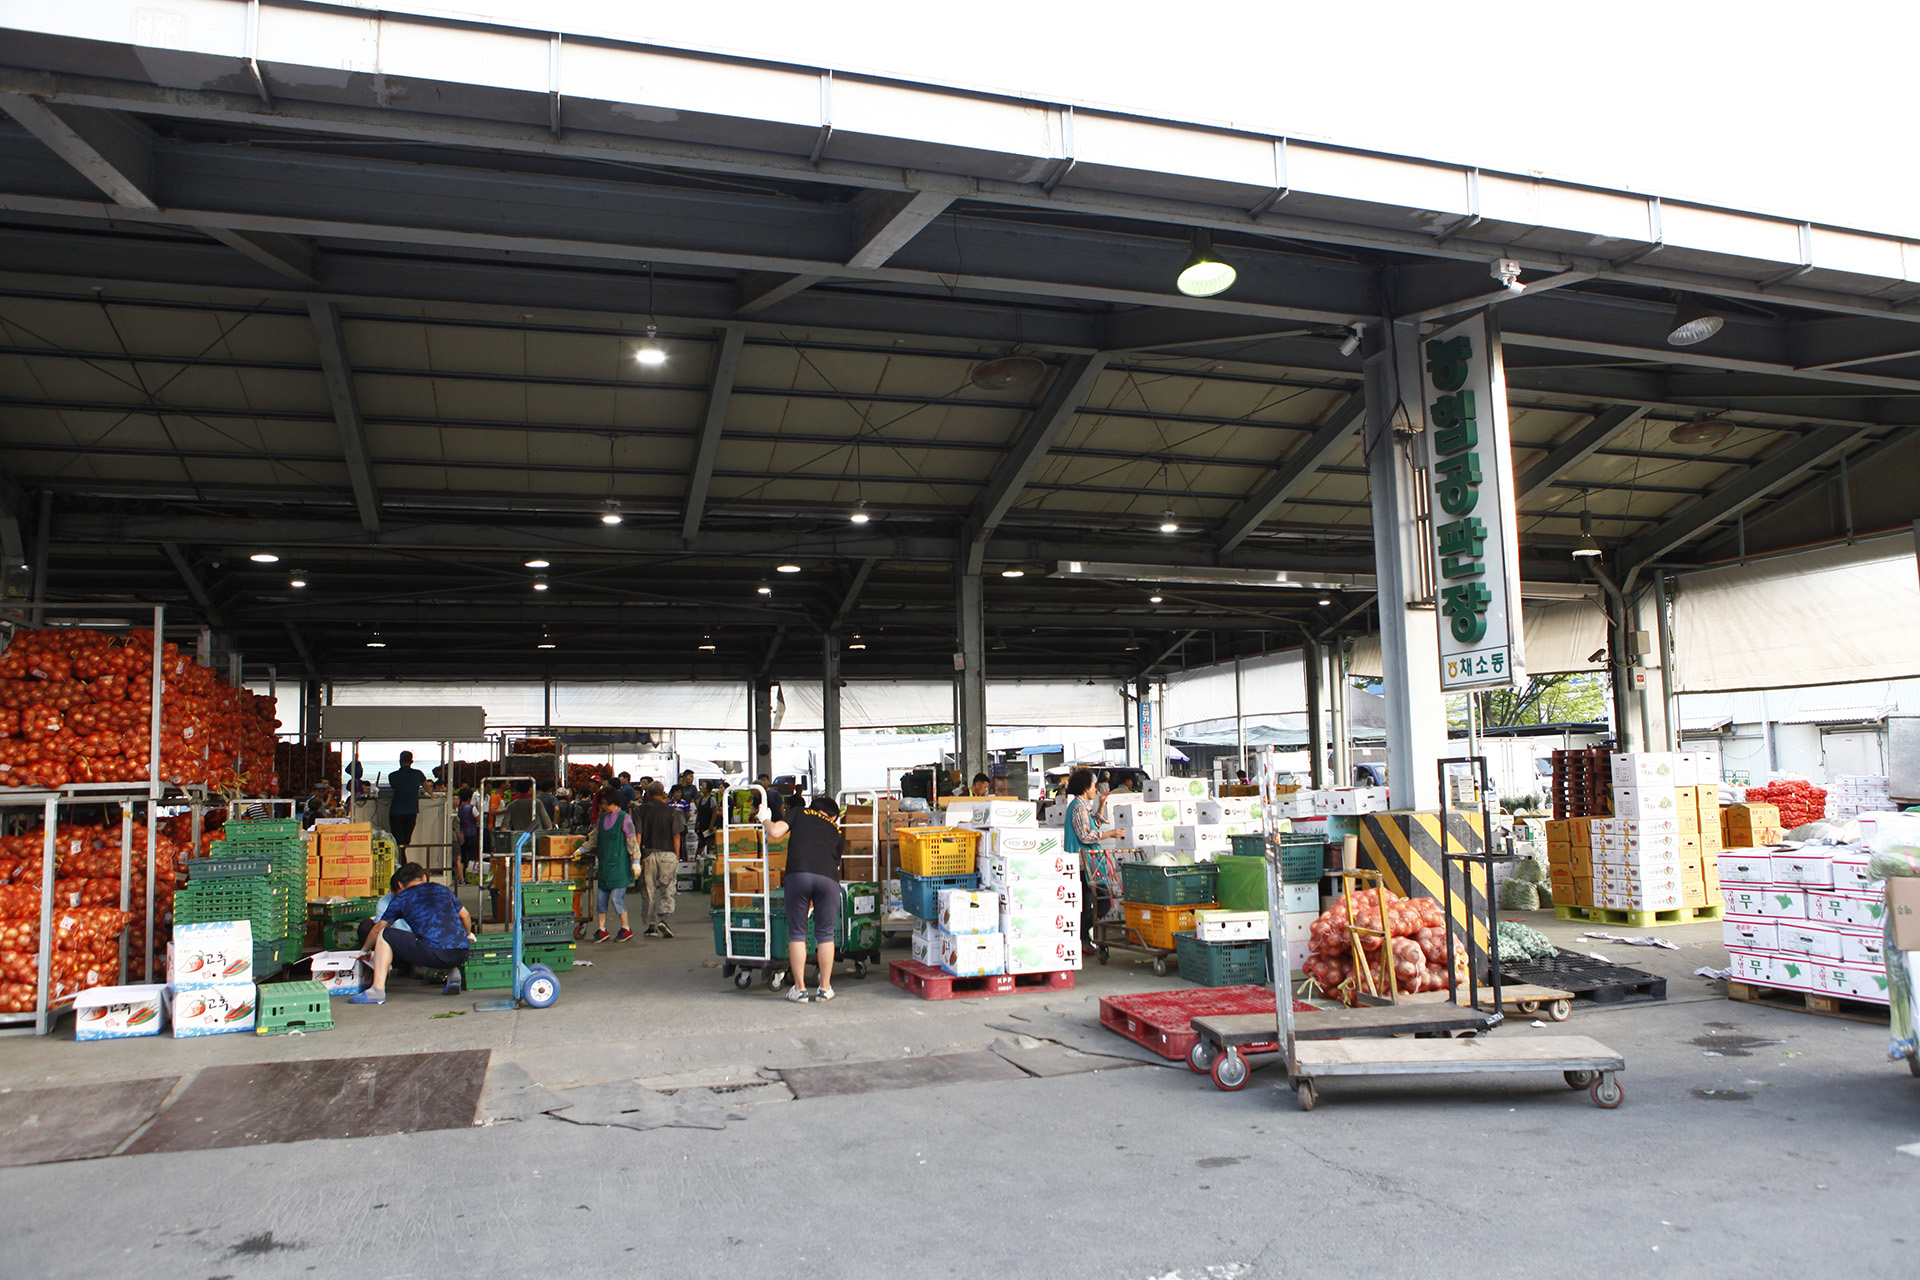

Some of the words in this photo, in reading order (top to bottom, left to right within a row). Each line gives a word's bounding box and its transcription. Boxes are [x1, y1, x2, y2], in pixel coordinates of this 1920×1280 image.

[1425, 335, 1492, 643] 농협공판장
[1460, 653, 1504, 677] 채소동
[1142, 704, 1150, 722] 쓰레기
[1062, 864, 1076, 880] 무
[1064, 892, 1079, 908] 무
[1739, 894, 1753, 909] 무
[1828, 900, 1842, 916] 무
[1063, 921, 1077, 937] 무
[205, 951, 227, 967] 고추
[1064, 950, 1078, 966] 무
[1749, 960, 1763, 975] 무
[997, 976, 1012, 984] KPP
[1832, 970, 1847, 987] 무
[207, 995, 229, 1012] 고추
